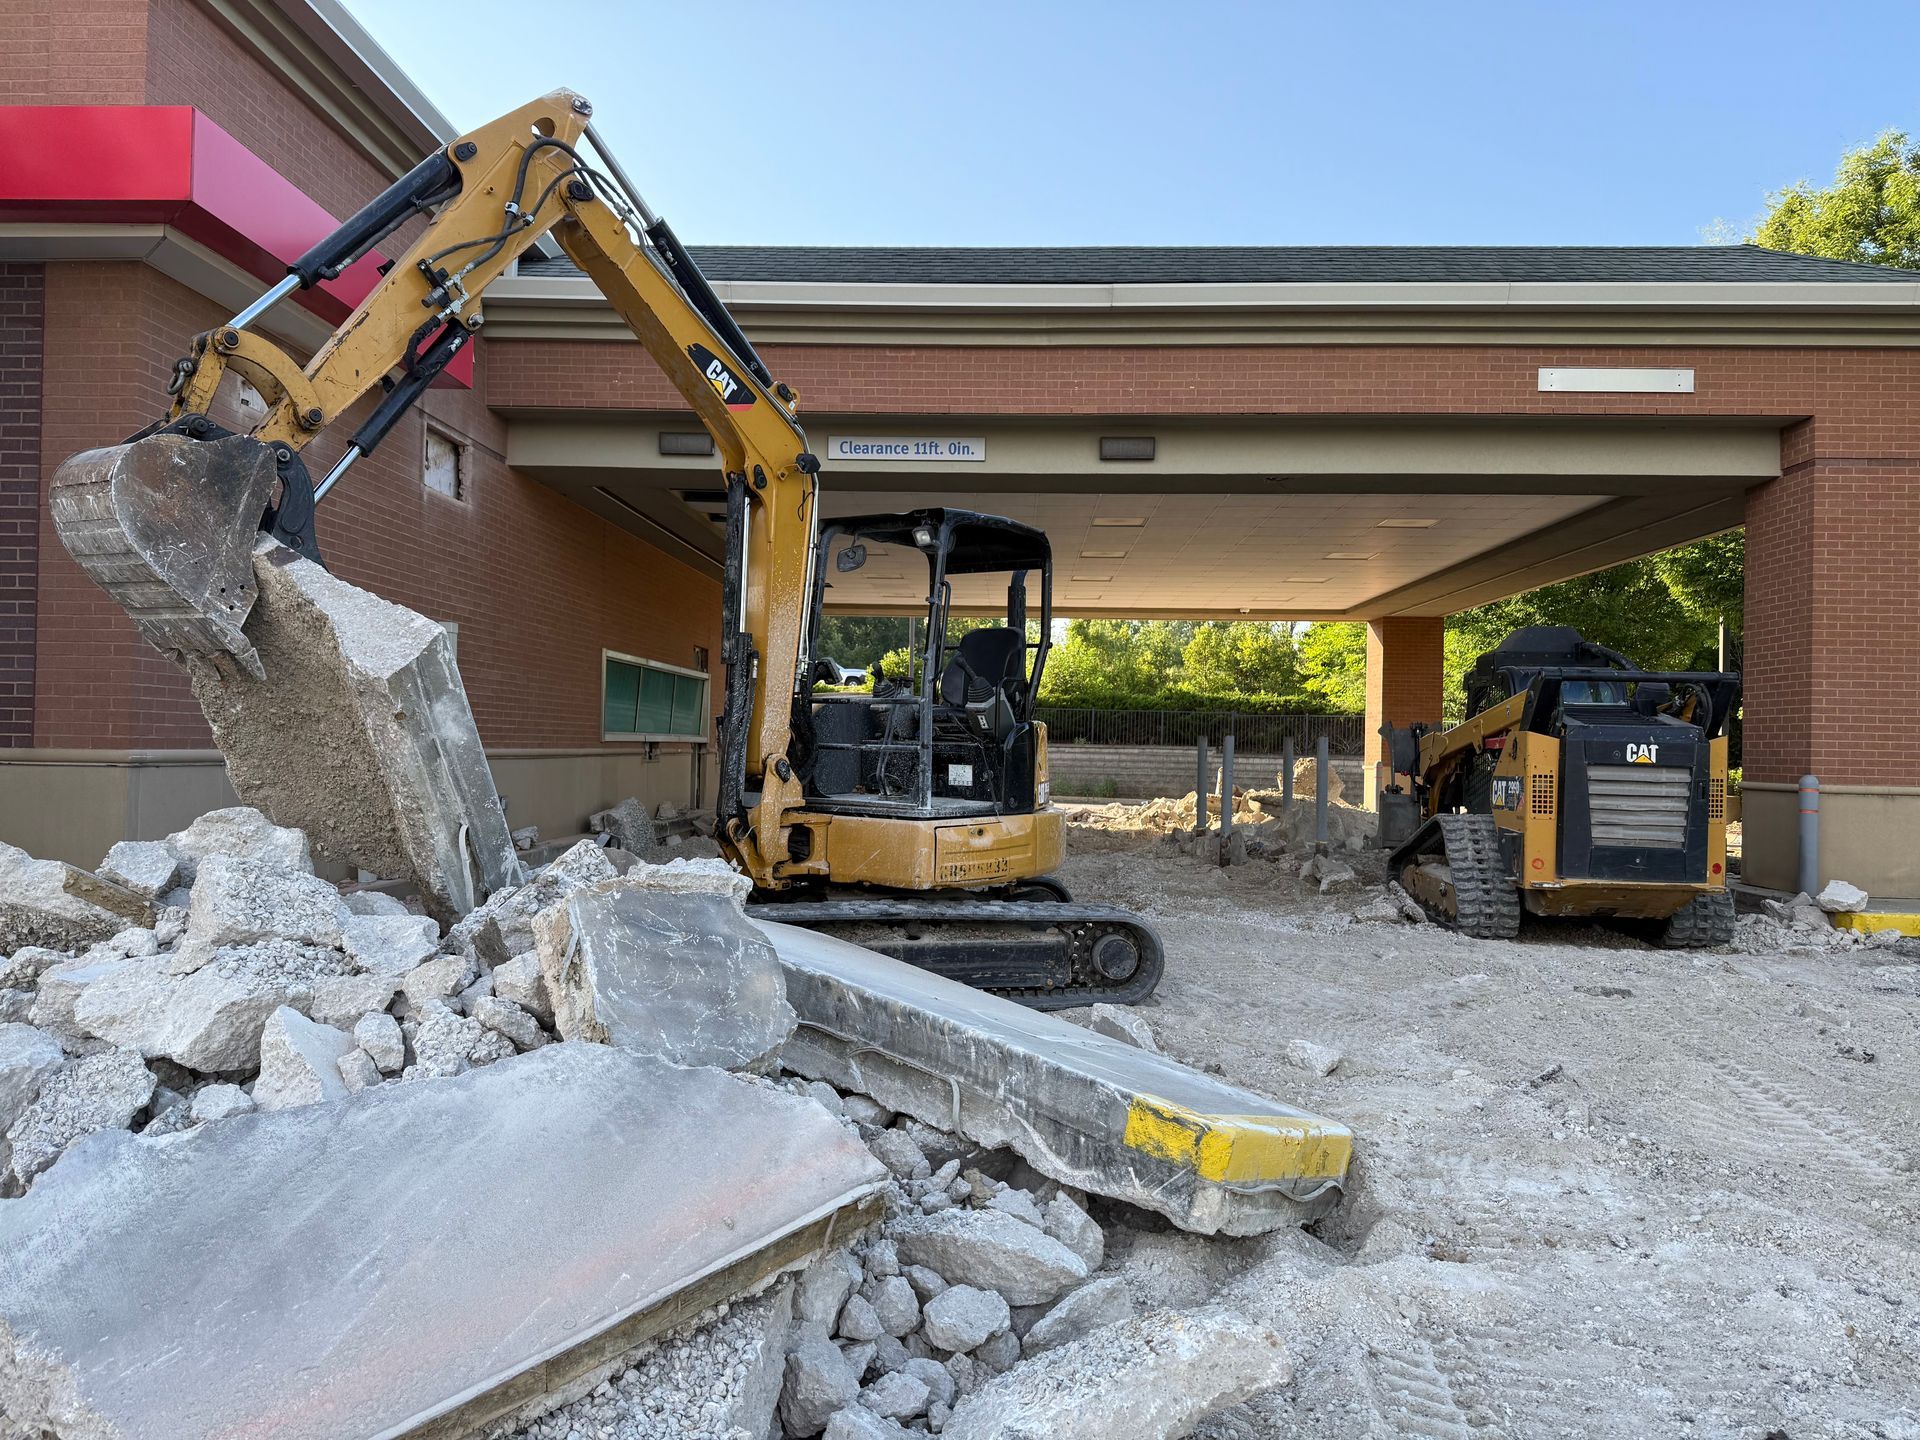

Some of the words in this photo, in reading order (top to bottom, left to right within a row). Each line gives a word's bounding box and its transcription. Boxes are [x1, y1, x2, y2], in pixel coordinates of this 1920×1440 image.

[706, 359, 738, 400] CAT
[839, 441, 909, 455] Clearance
[914, 441, 944, 455] 11ft.
[1626, 743, 1659, 763] CAT
[1492, 780, 1506, 805] CAT
